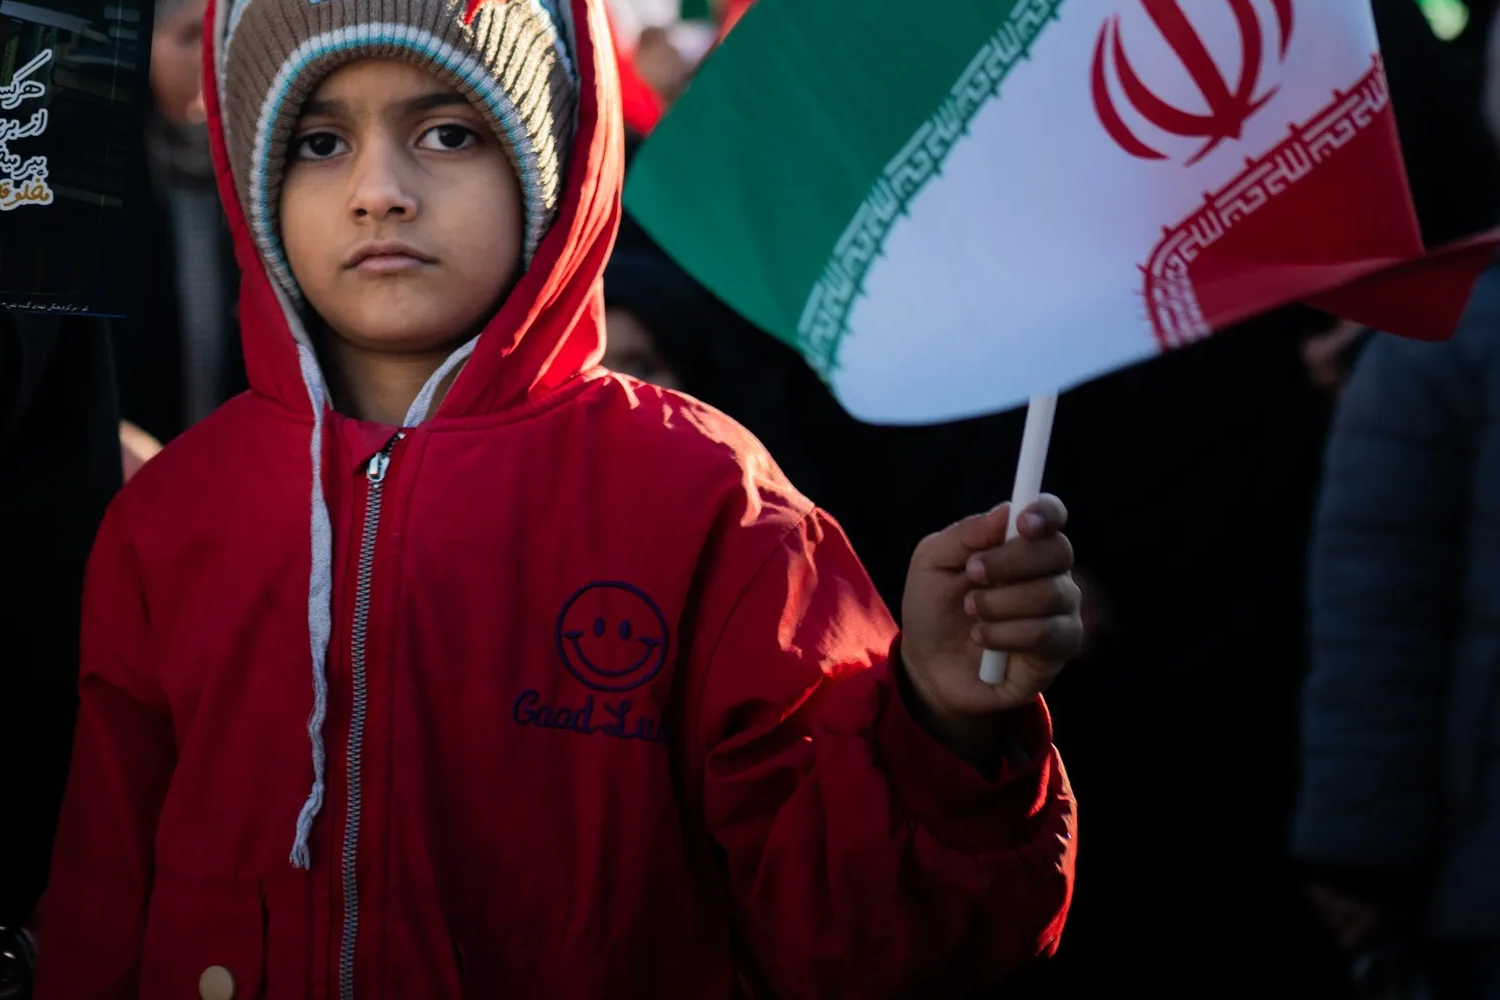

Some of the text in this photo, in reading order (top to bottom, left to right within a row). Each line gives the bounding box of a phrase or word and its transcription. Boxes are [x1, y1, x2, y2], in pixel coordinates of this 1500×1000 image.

[18, 109, 48, 136] از
[11, 155, 48, 180] پیر
[511, 688, 593, 735] Good
